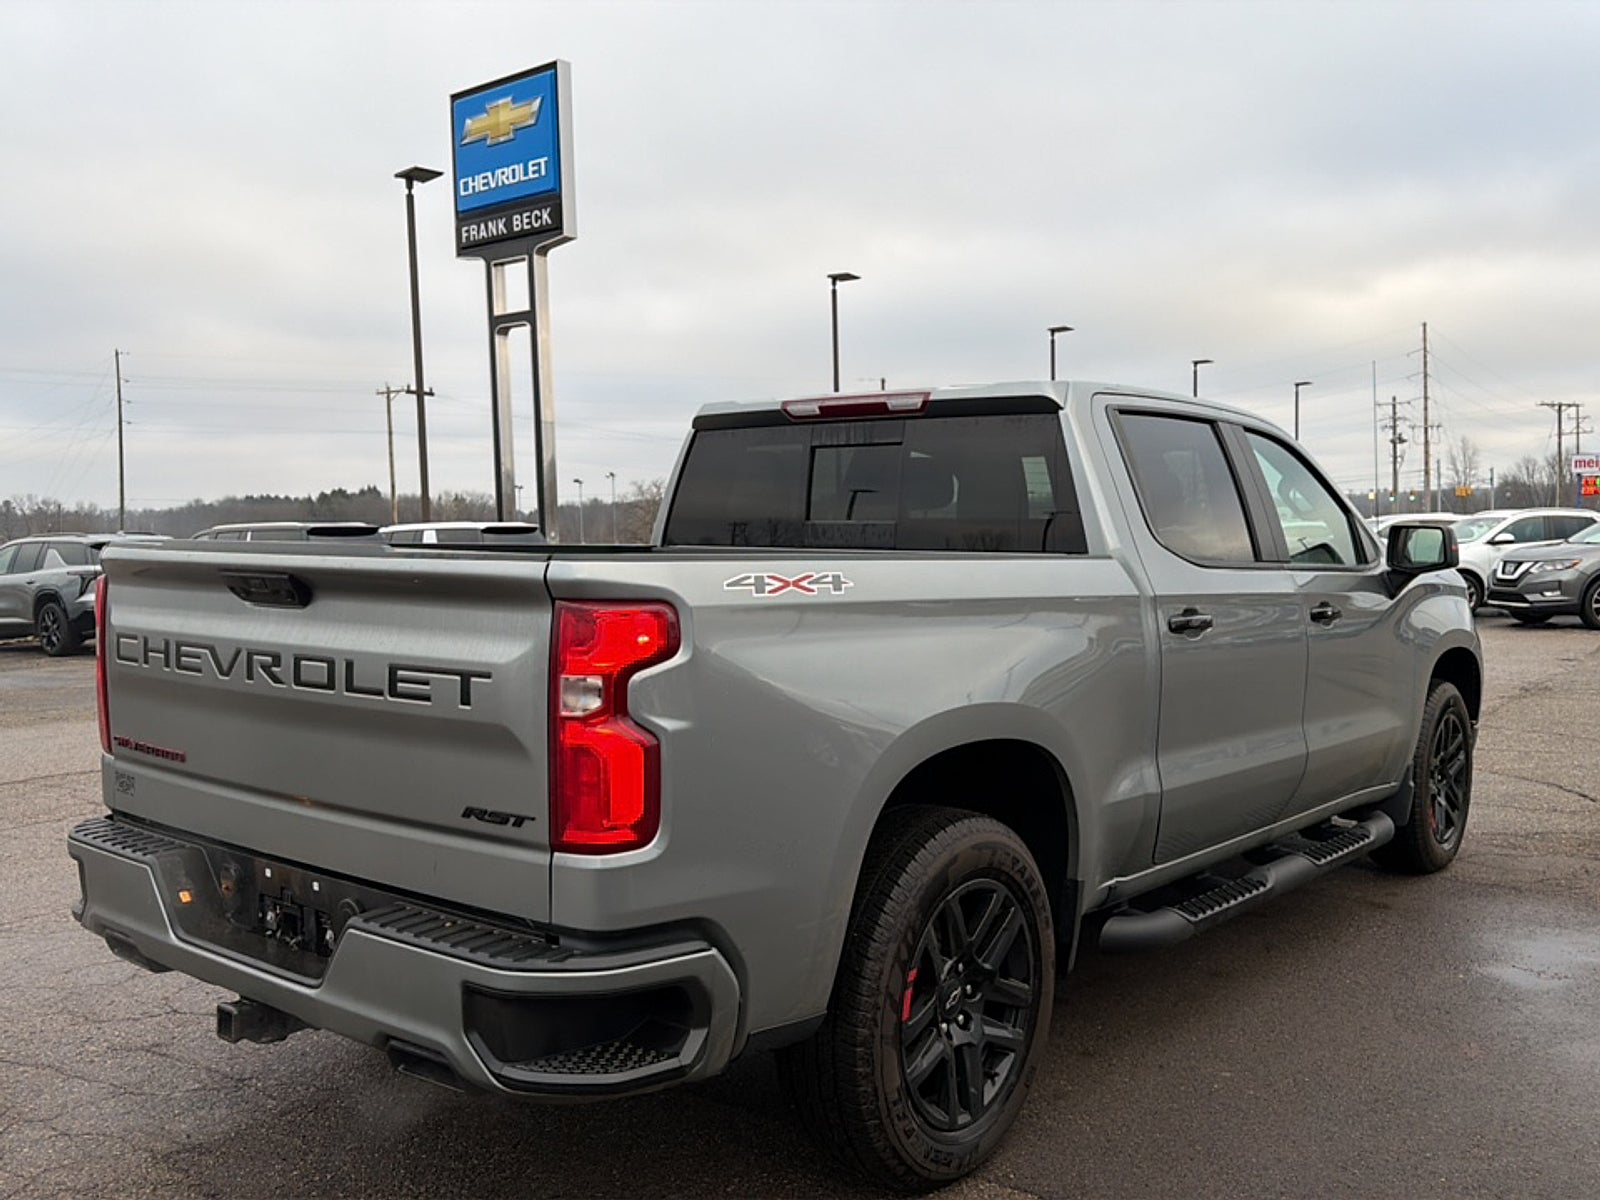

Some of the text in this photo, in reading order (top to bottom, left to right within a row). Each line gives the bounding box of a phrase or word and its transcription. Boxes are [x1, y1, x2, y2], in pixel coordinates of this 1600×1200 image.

[459, 157, 548, 196] CHEVROLET
[461, 207, 552, 243] FRANK BECK
[115, 632, 493, 709] CHEVROLET
[461, 806, 536, 828] RST
